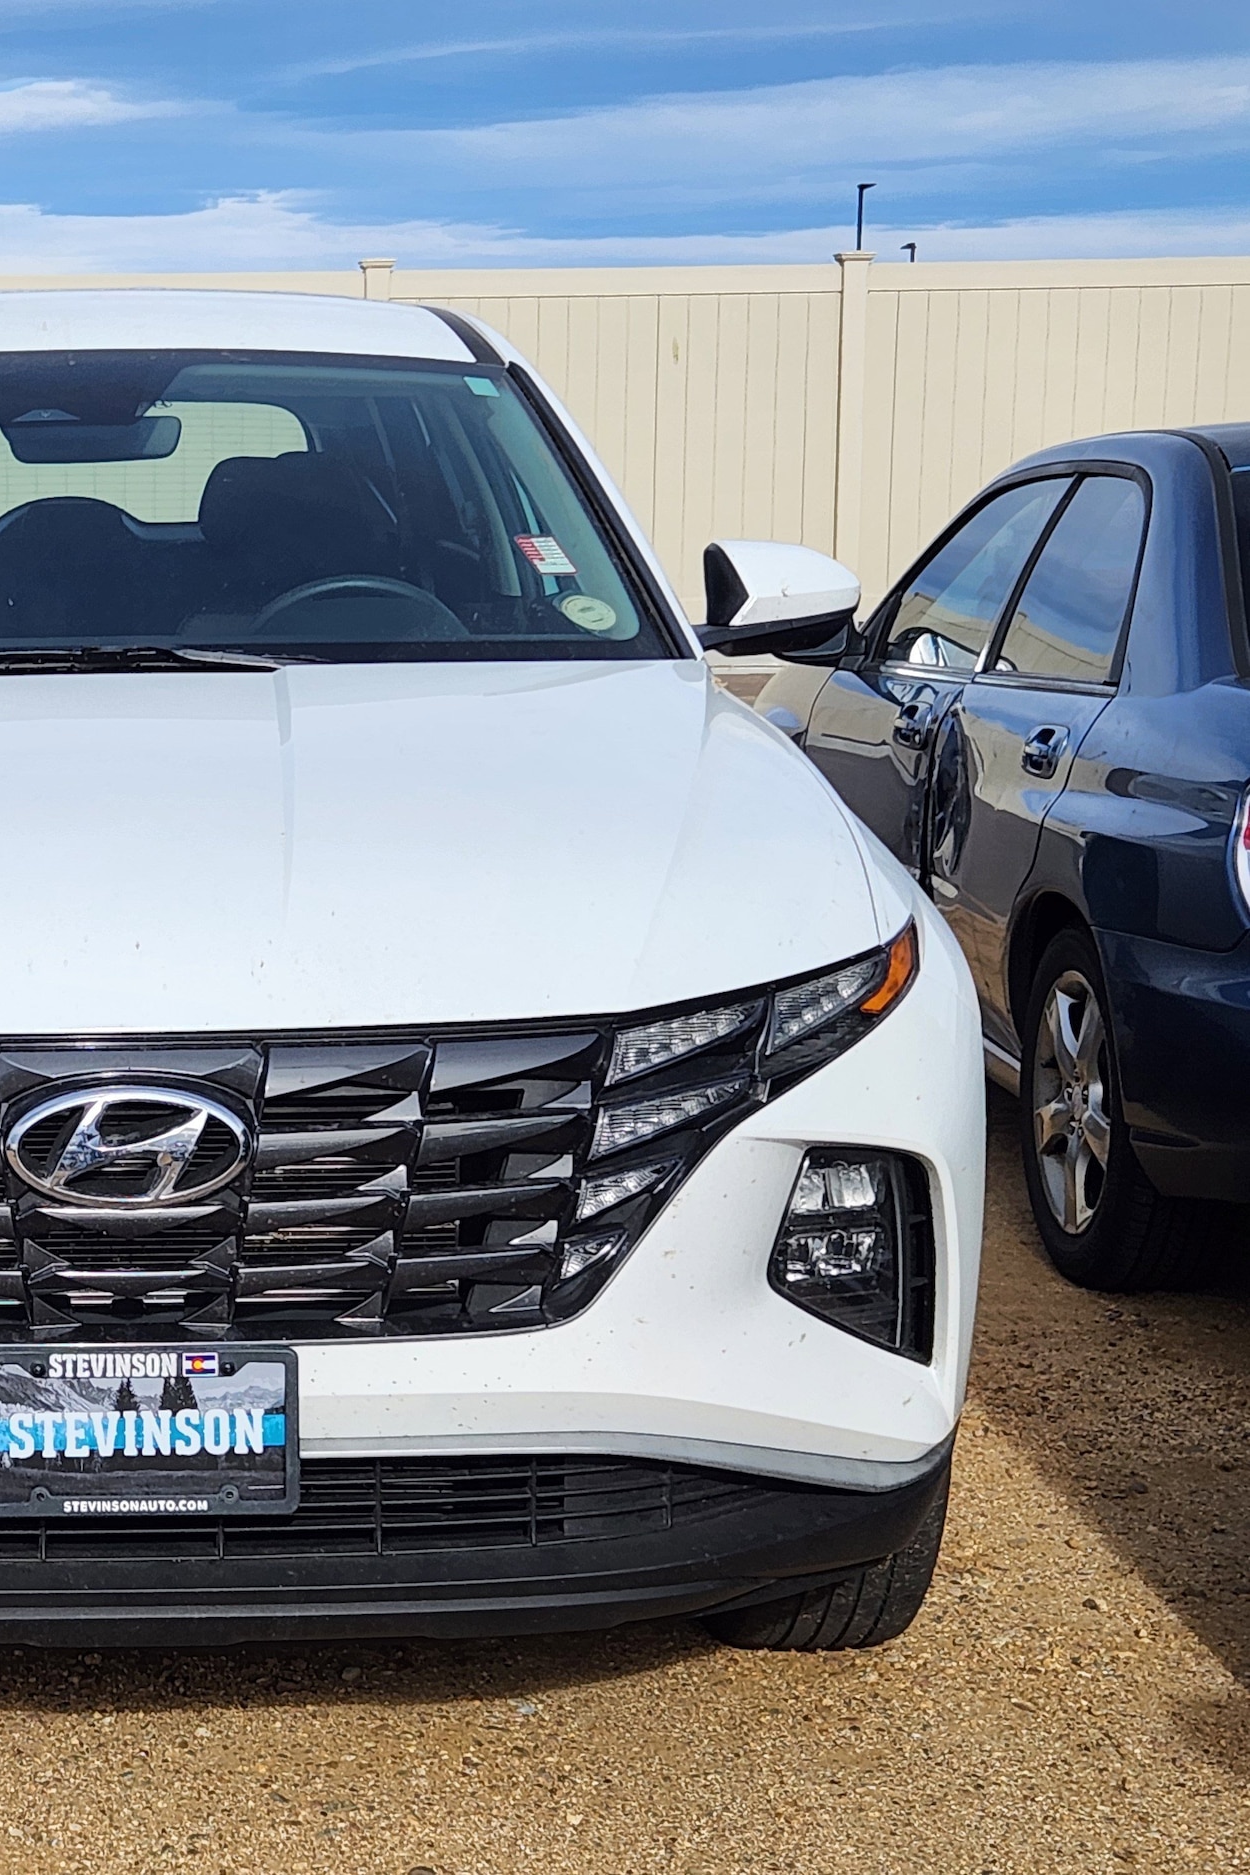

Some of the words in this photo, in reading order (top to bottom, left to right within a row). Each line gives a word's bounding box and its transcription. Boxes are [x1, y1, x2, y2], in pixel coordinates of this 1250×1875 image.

[49, 1353, 177, 1377] STEVINSON
[8, 1409, 264, 1458] STEVINSON
[63, 1500, 208, 1512] STEVINSONAUTO.COM
